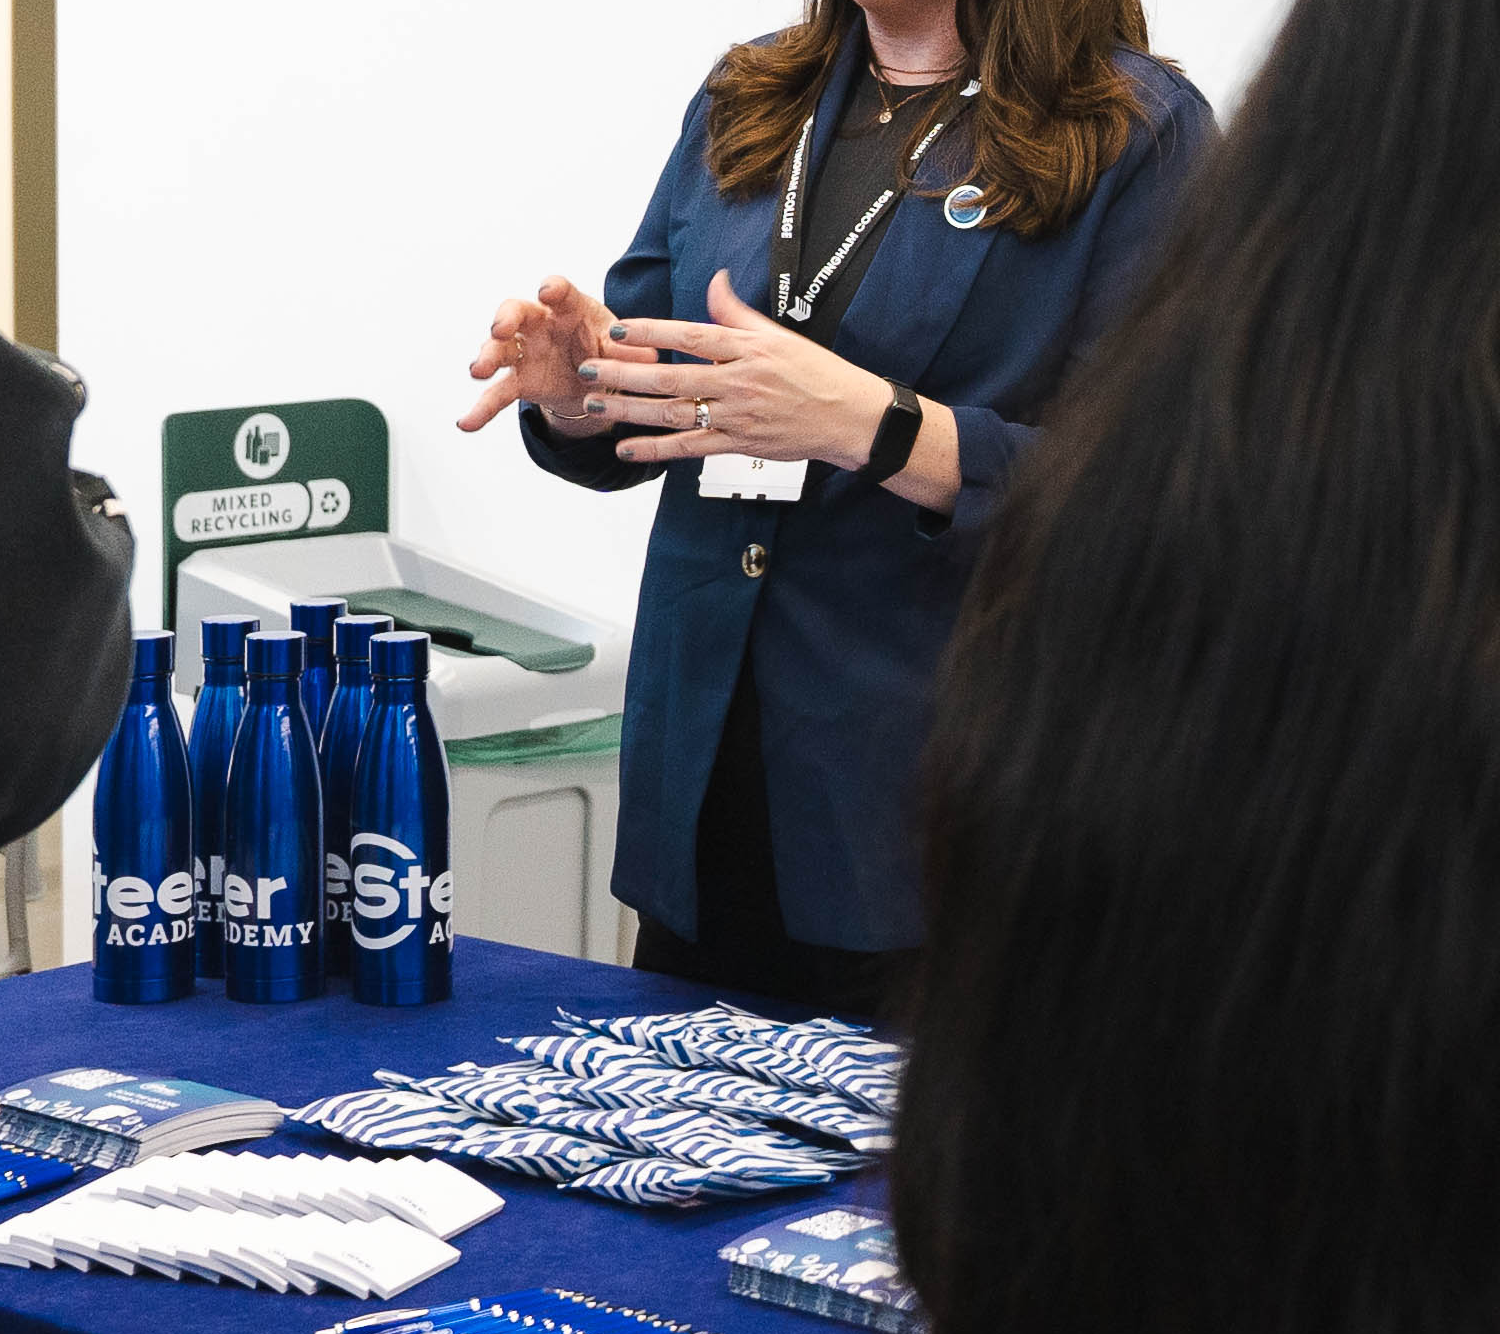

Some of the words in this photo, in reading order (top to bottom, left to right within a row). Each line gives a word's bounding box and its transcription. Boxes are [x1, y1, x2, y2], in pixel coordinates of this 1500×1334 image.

[780, 191, 797, 239] COLLEGE
[804, 232, 859, 303] NOTTINGHAM
[212, 492, 272, 513] MIXED
[191, 509, 293, 534] RECYCLING
[224, 920, 315, 948] DEMY
